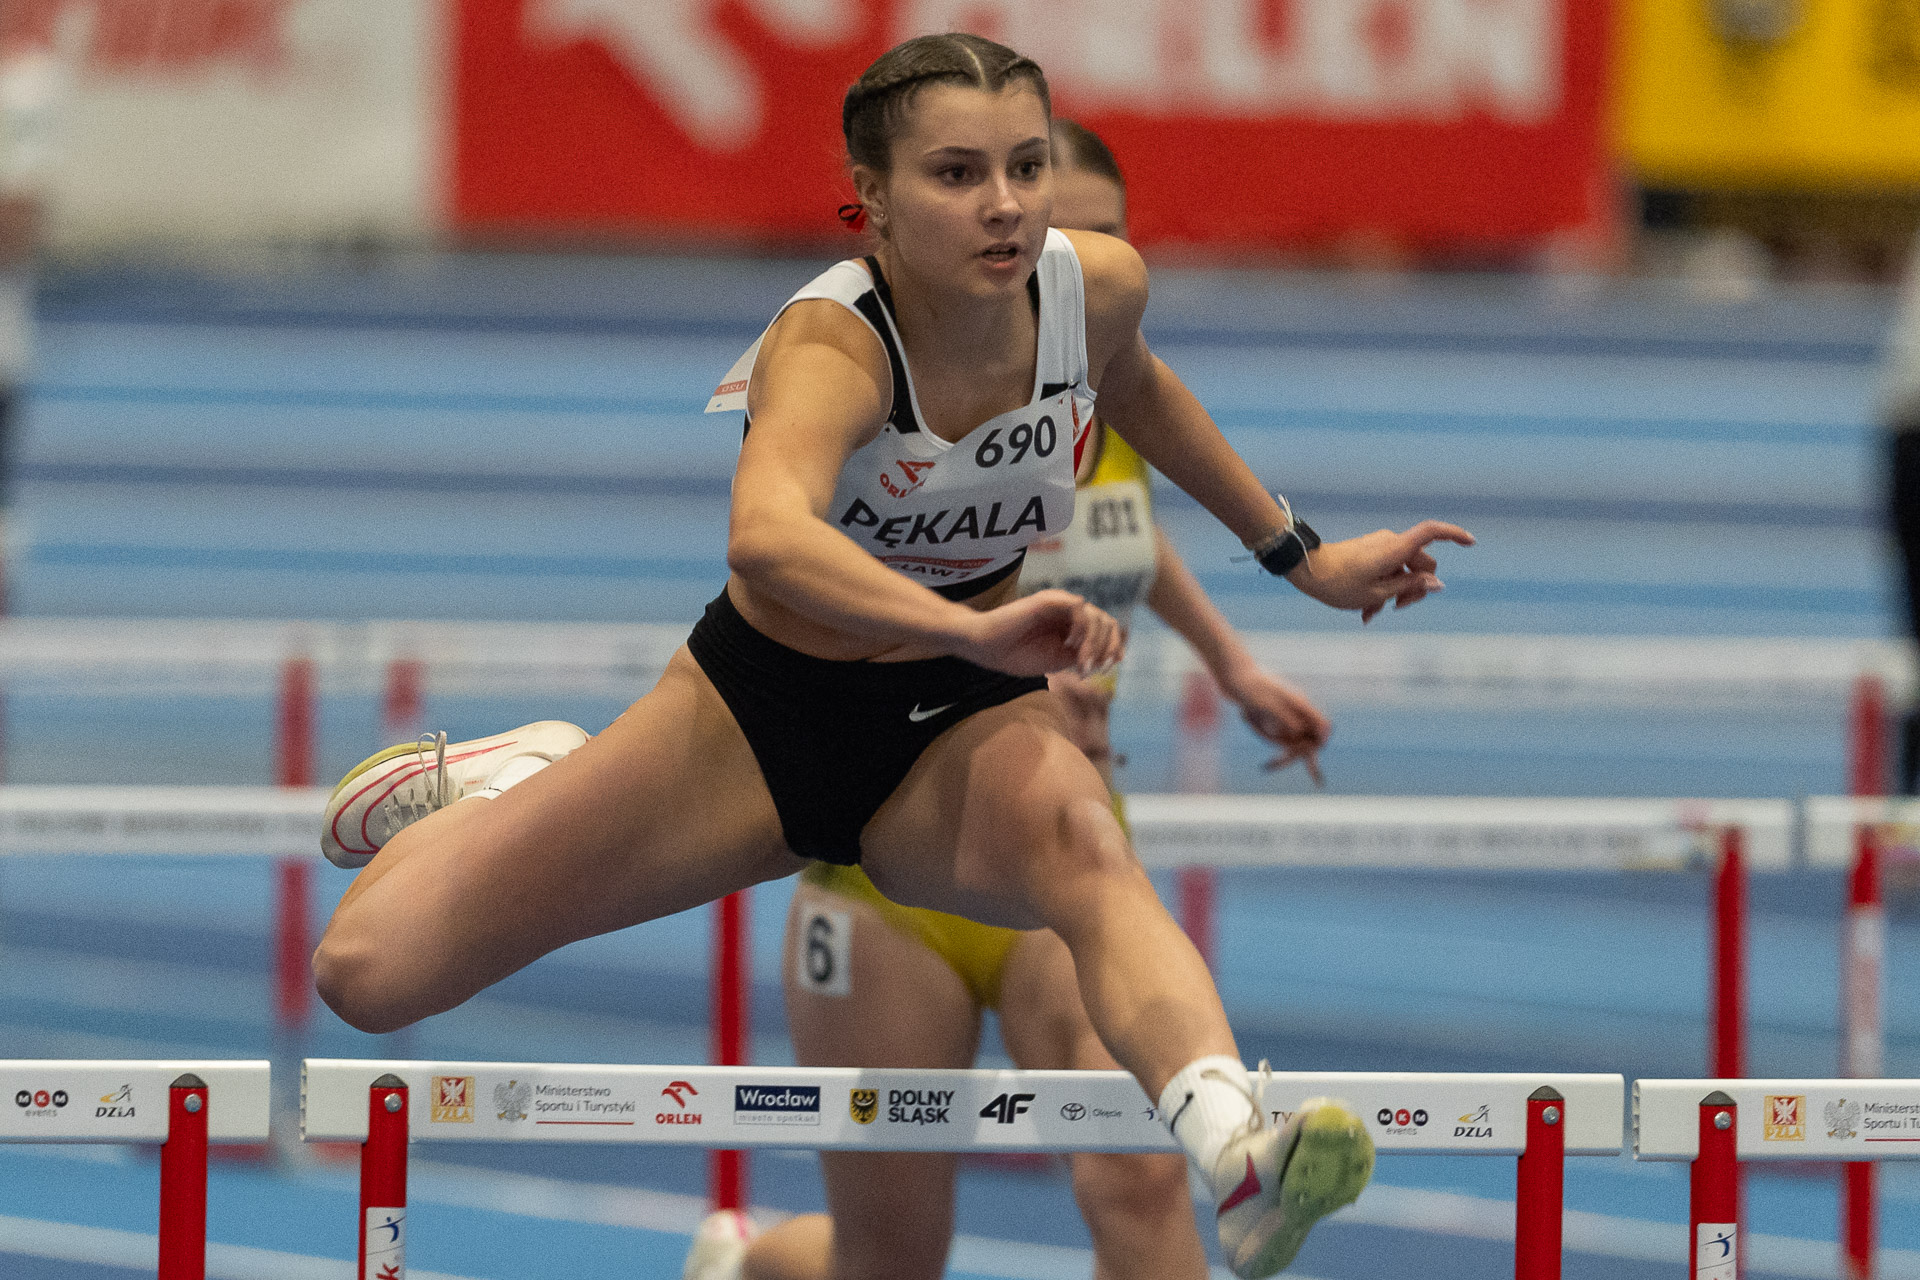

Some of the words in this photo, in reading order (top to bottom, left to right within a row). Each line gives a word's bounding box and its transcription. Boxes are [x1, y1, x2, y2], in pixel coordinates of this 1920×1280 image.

[975, 415, 1057, 468] 690
[840, 495, 1047, 548] PĘKALA
[807, 915, 834, 984] 6
[535, 1084, 611, 1097] Ministerstwo
[740, 1088, 817, 1106] Wrocław
[888, 1089, 955, 1106] DOLNY
[25, 1109, 57, 1117] events
[535, 1100, 574, 1113] Sportu
[584, 1100, 636, 1113] Turystyki
[979, 1093, 1036, 1123] 4F
[1864, 1103, 1920, 1114] Ministerst
[655, 1113, 702, 1124] ORLEN
[888, 1104, 950, 1125] ŚLĄSK
[1864, 1118, 1899, 1131] Sportu
[1386, 1127, 1418, 1136] events
[1453, 1127, 1493, 1138] DZLA
